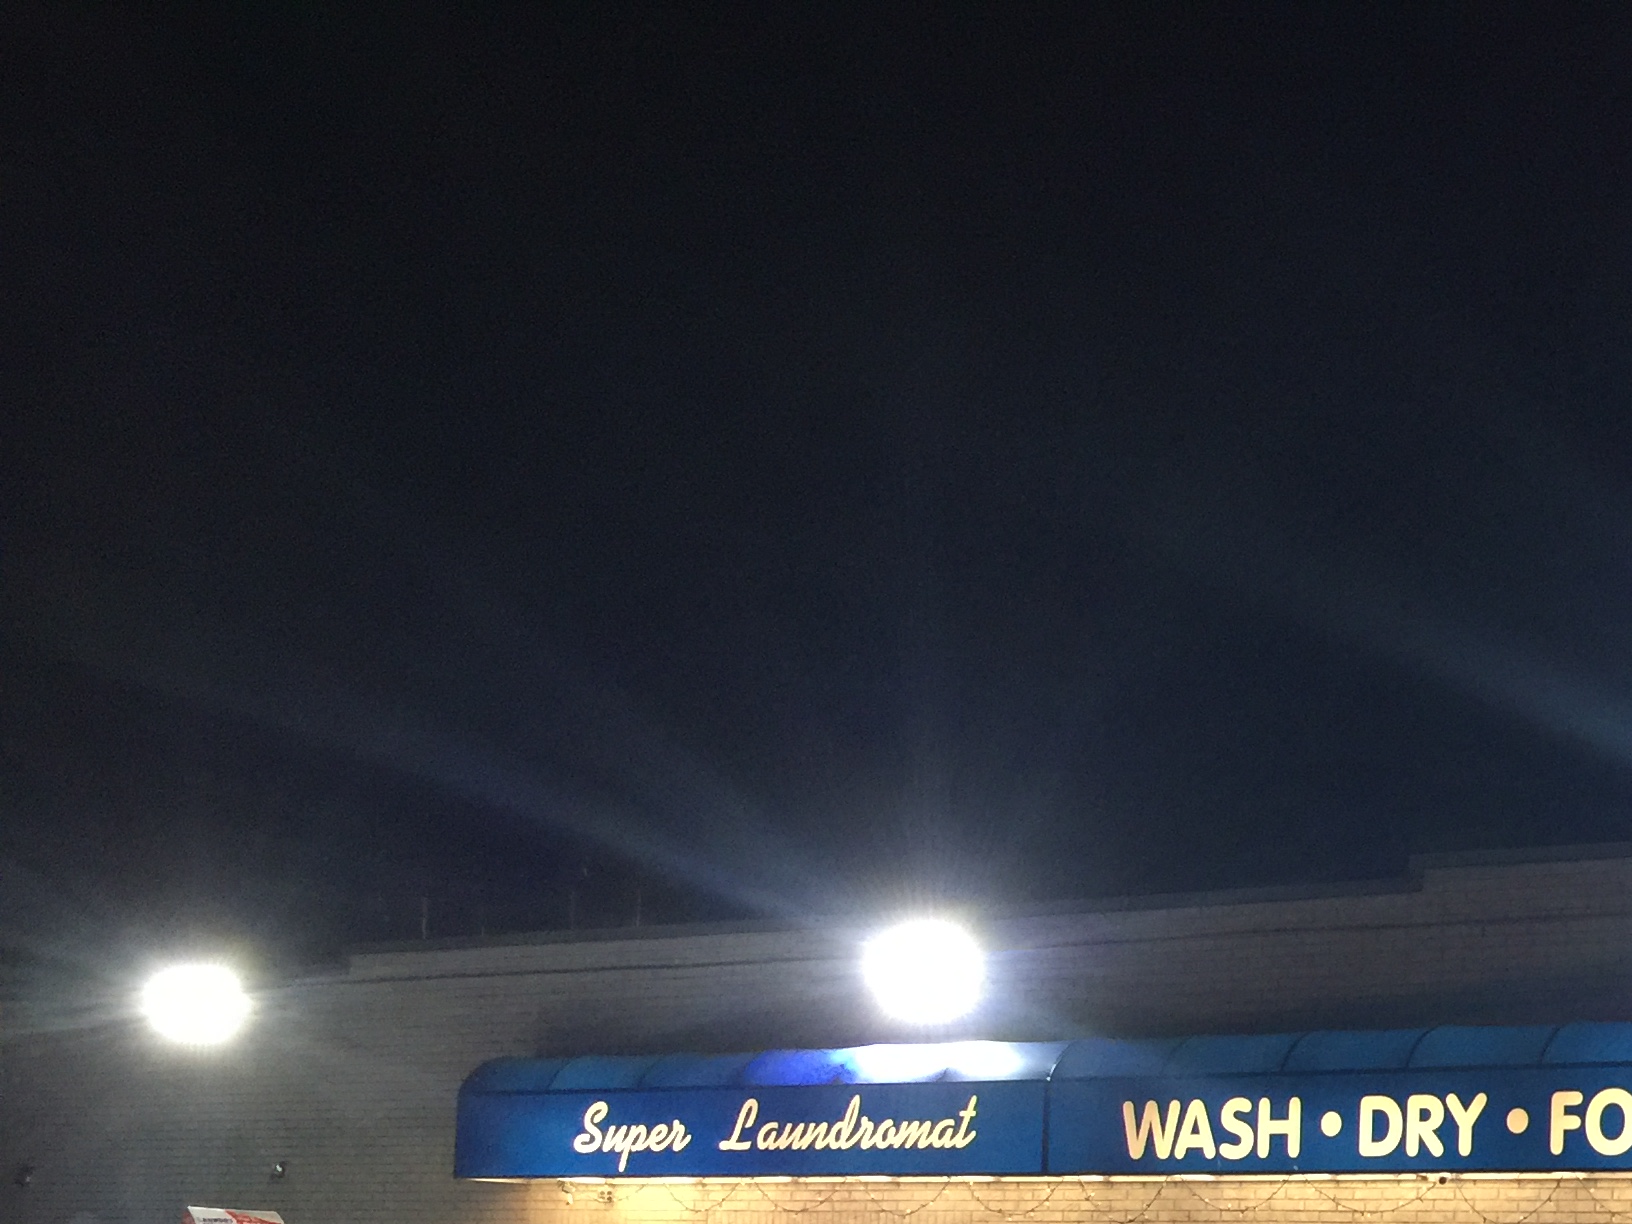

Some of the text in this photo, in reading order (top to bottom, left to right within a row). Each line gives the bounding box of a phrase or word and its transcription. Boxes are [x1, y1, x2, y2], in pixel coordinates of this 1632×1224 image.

[573, 1094, 977, 1172] Super Laundromat
[1123, 1097, 1301, 1160] WASH
[1359, 1093, 1487, 1157] DRY
